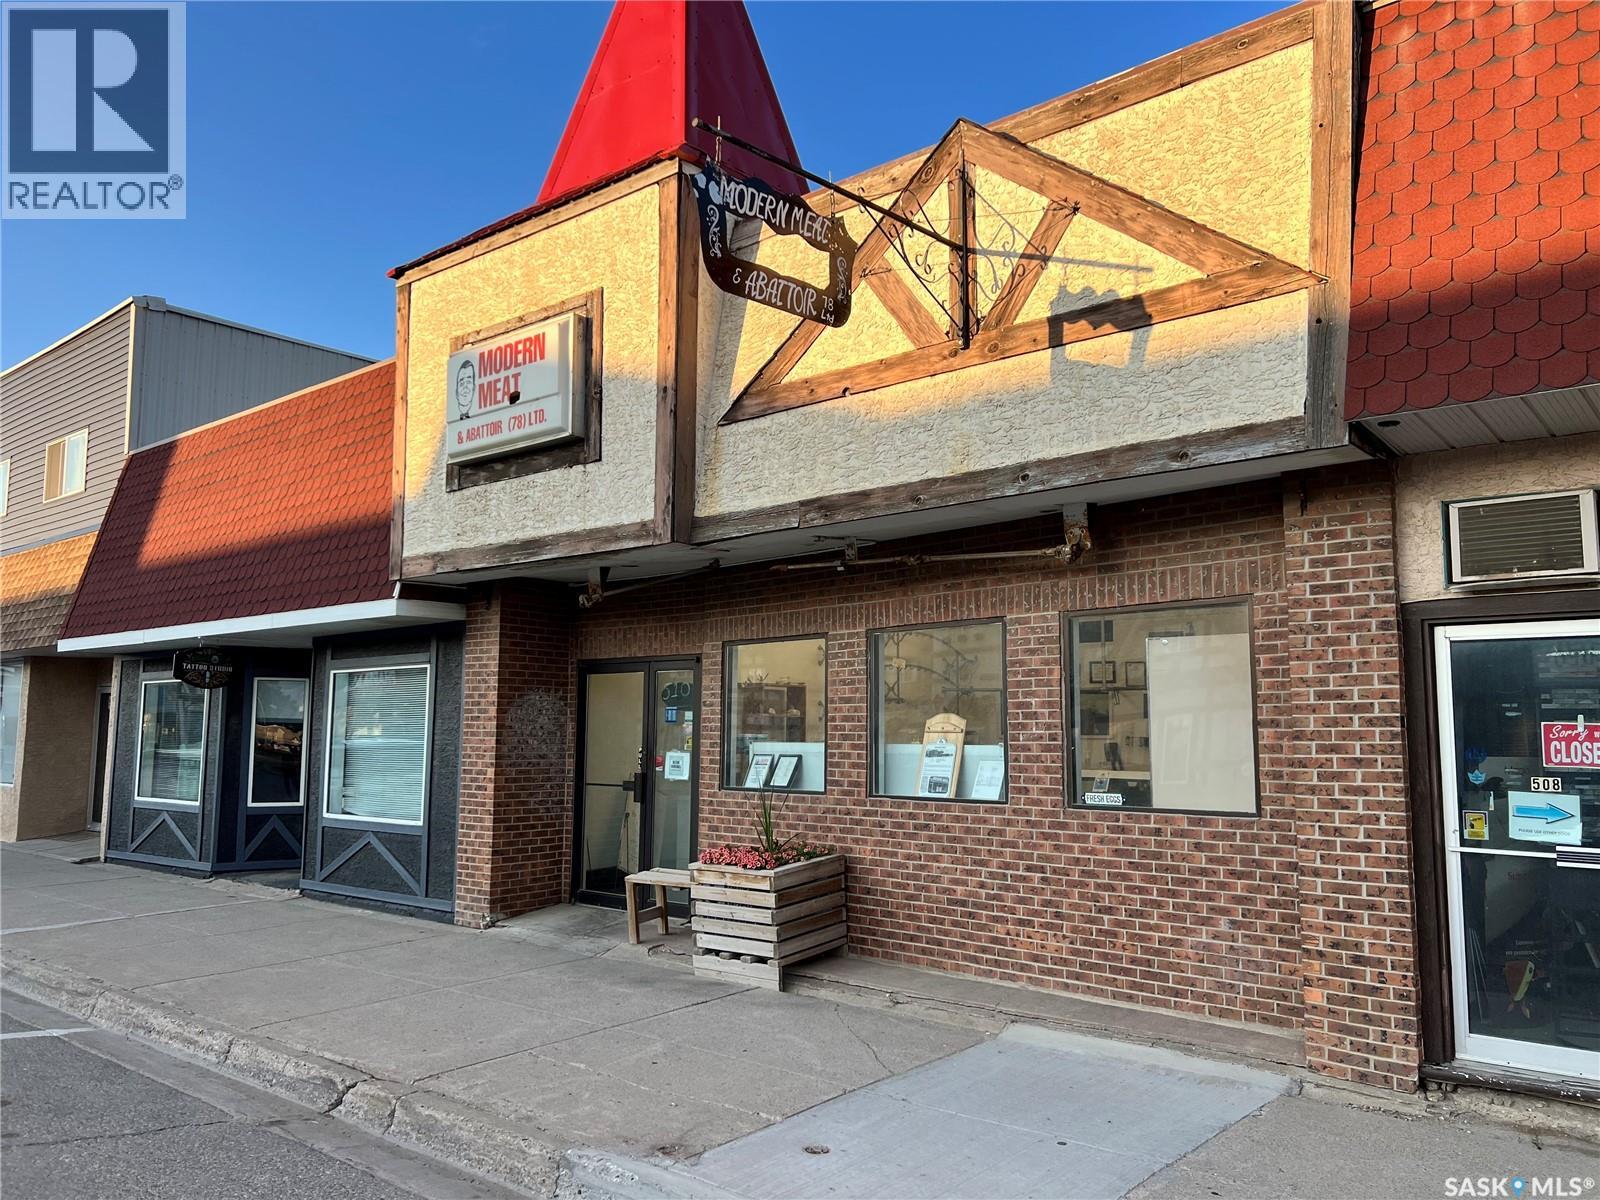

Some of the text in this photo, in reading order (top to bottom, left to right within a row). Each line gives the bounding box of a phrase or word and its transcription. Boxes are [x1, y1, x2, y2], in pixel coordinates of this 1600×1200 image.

[719, 175, 832, 244] MODERN MEAT
[745, 270, 817, 316] ABATTOIR
[822, 296, 834, 311] 78
[820, 309, 835, 323] Ltd
[478, 332, 546, 379] MODERN
[478, 372, 521, 409] MEAT
[457, 408, 547, 444] & ABATTOIR (78) LTD.
[1549, 725, 1589, 741] Sorry
[1550, 741, 1600, 764] CLOSE
[1532, 779, 1560, 790] 508
[1086, 794, 1121, 804] FRESH EGGS
